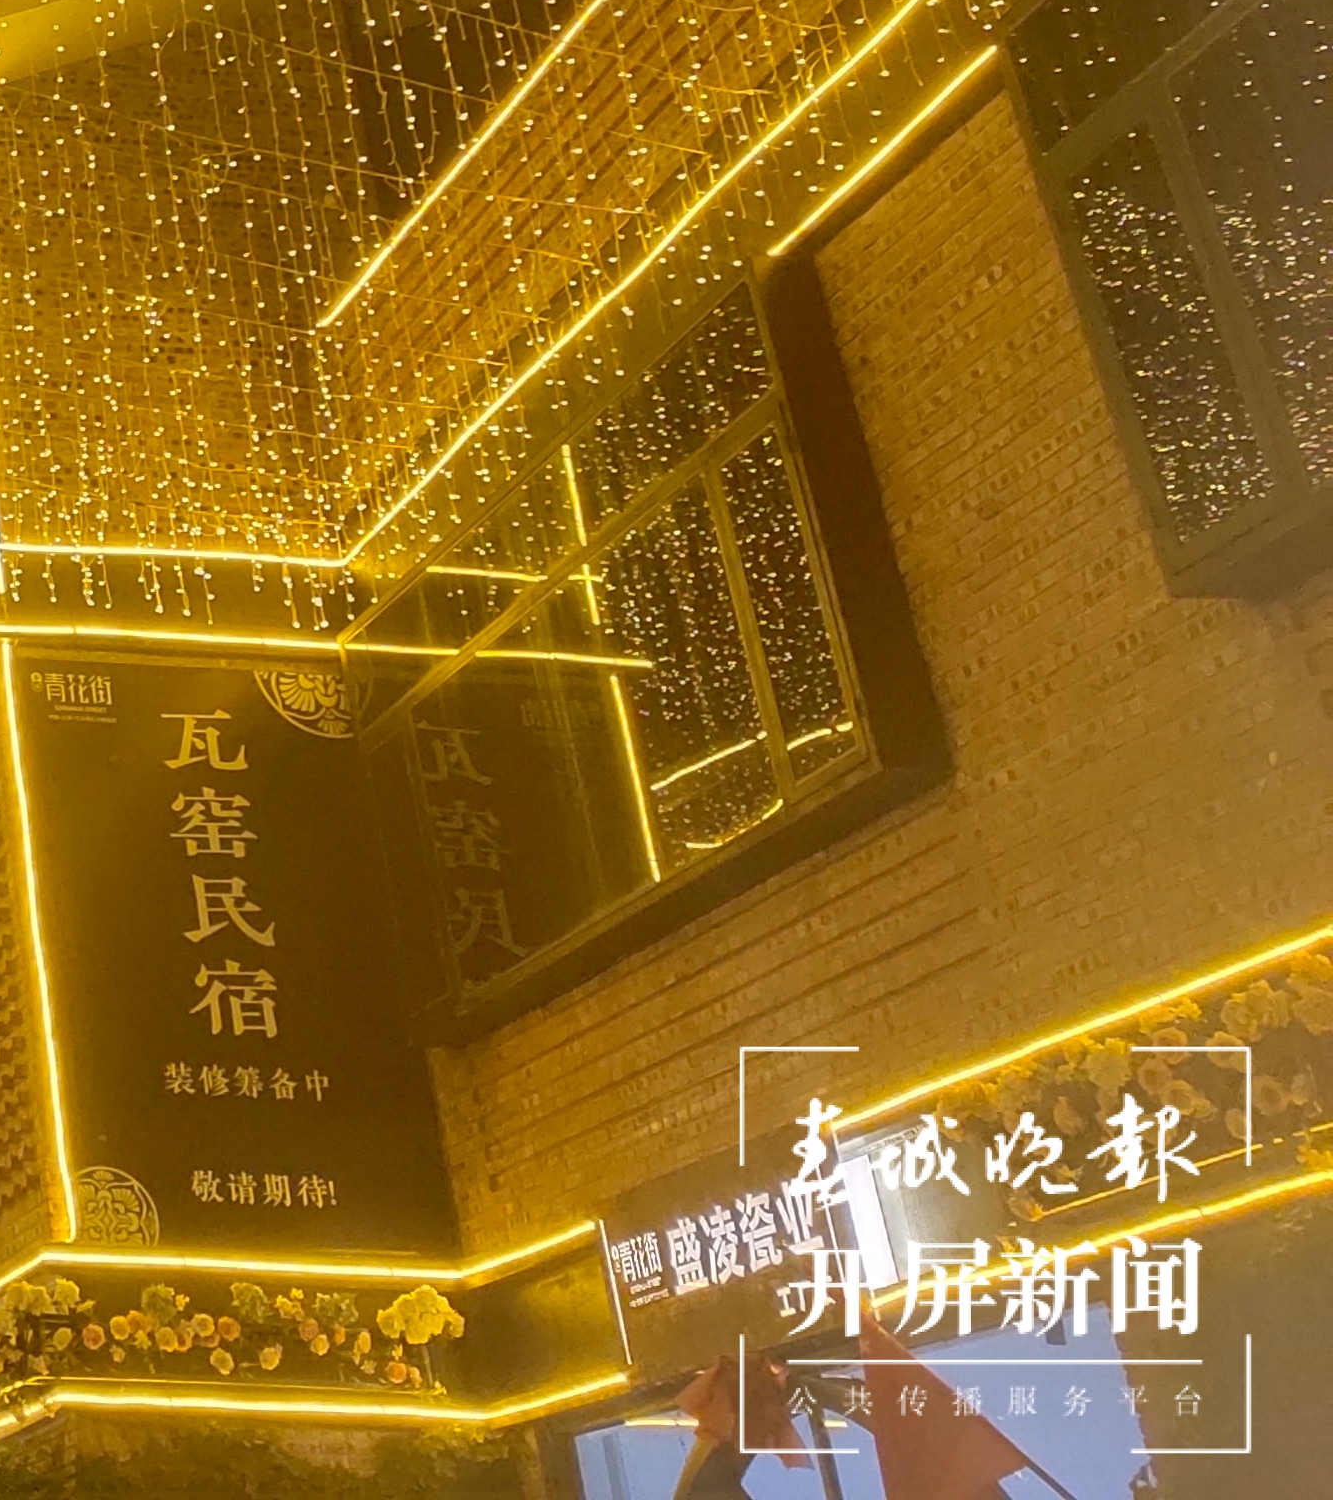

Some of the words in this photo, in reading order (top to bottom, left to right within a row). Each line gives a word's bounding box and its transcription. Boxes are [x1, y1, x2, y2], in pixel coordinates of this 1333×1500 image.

[44, 672, 112, 705] 青花街
[160, 708, 279, 1040] 瓦窑民宿
[163, 1063, 330, 1102] 装修筹备中
[191, 1169, 337, 1206] 敬请期待!
[666, 1181, 825, 1296] 盛凌瓷业
